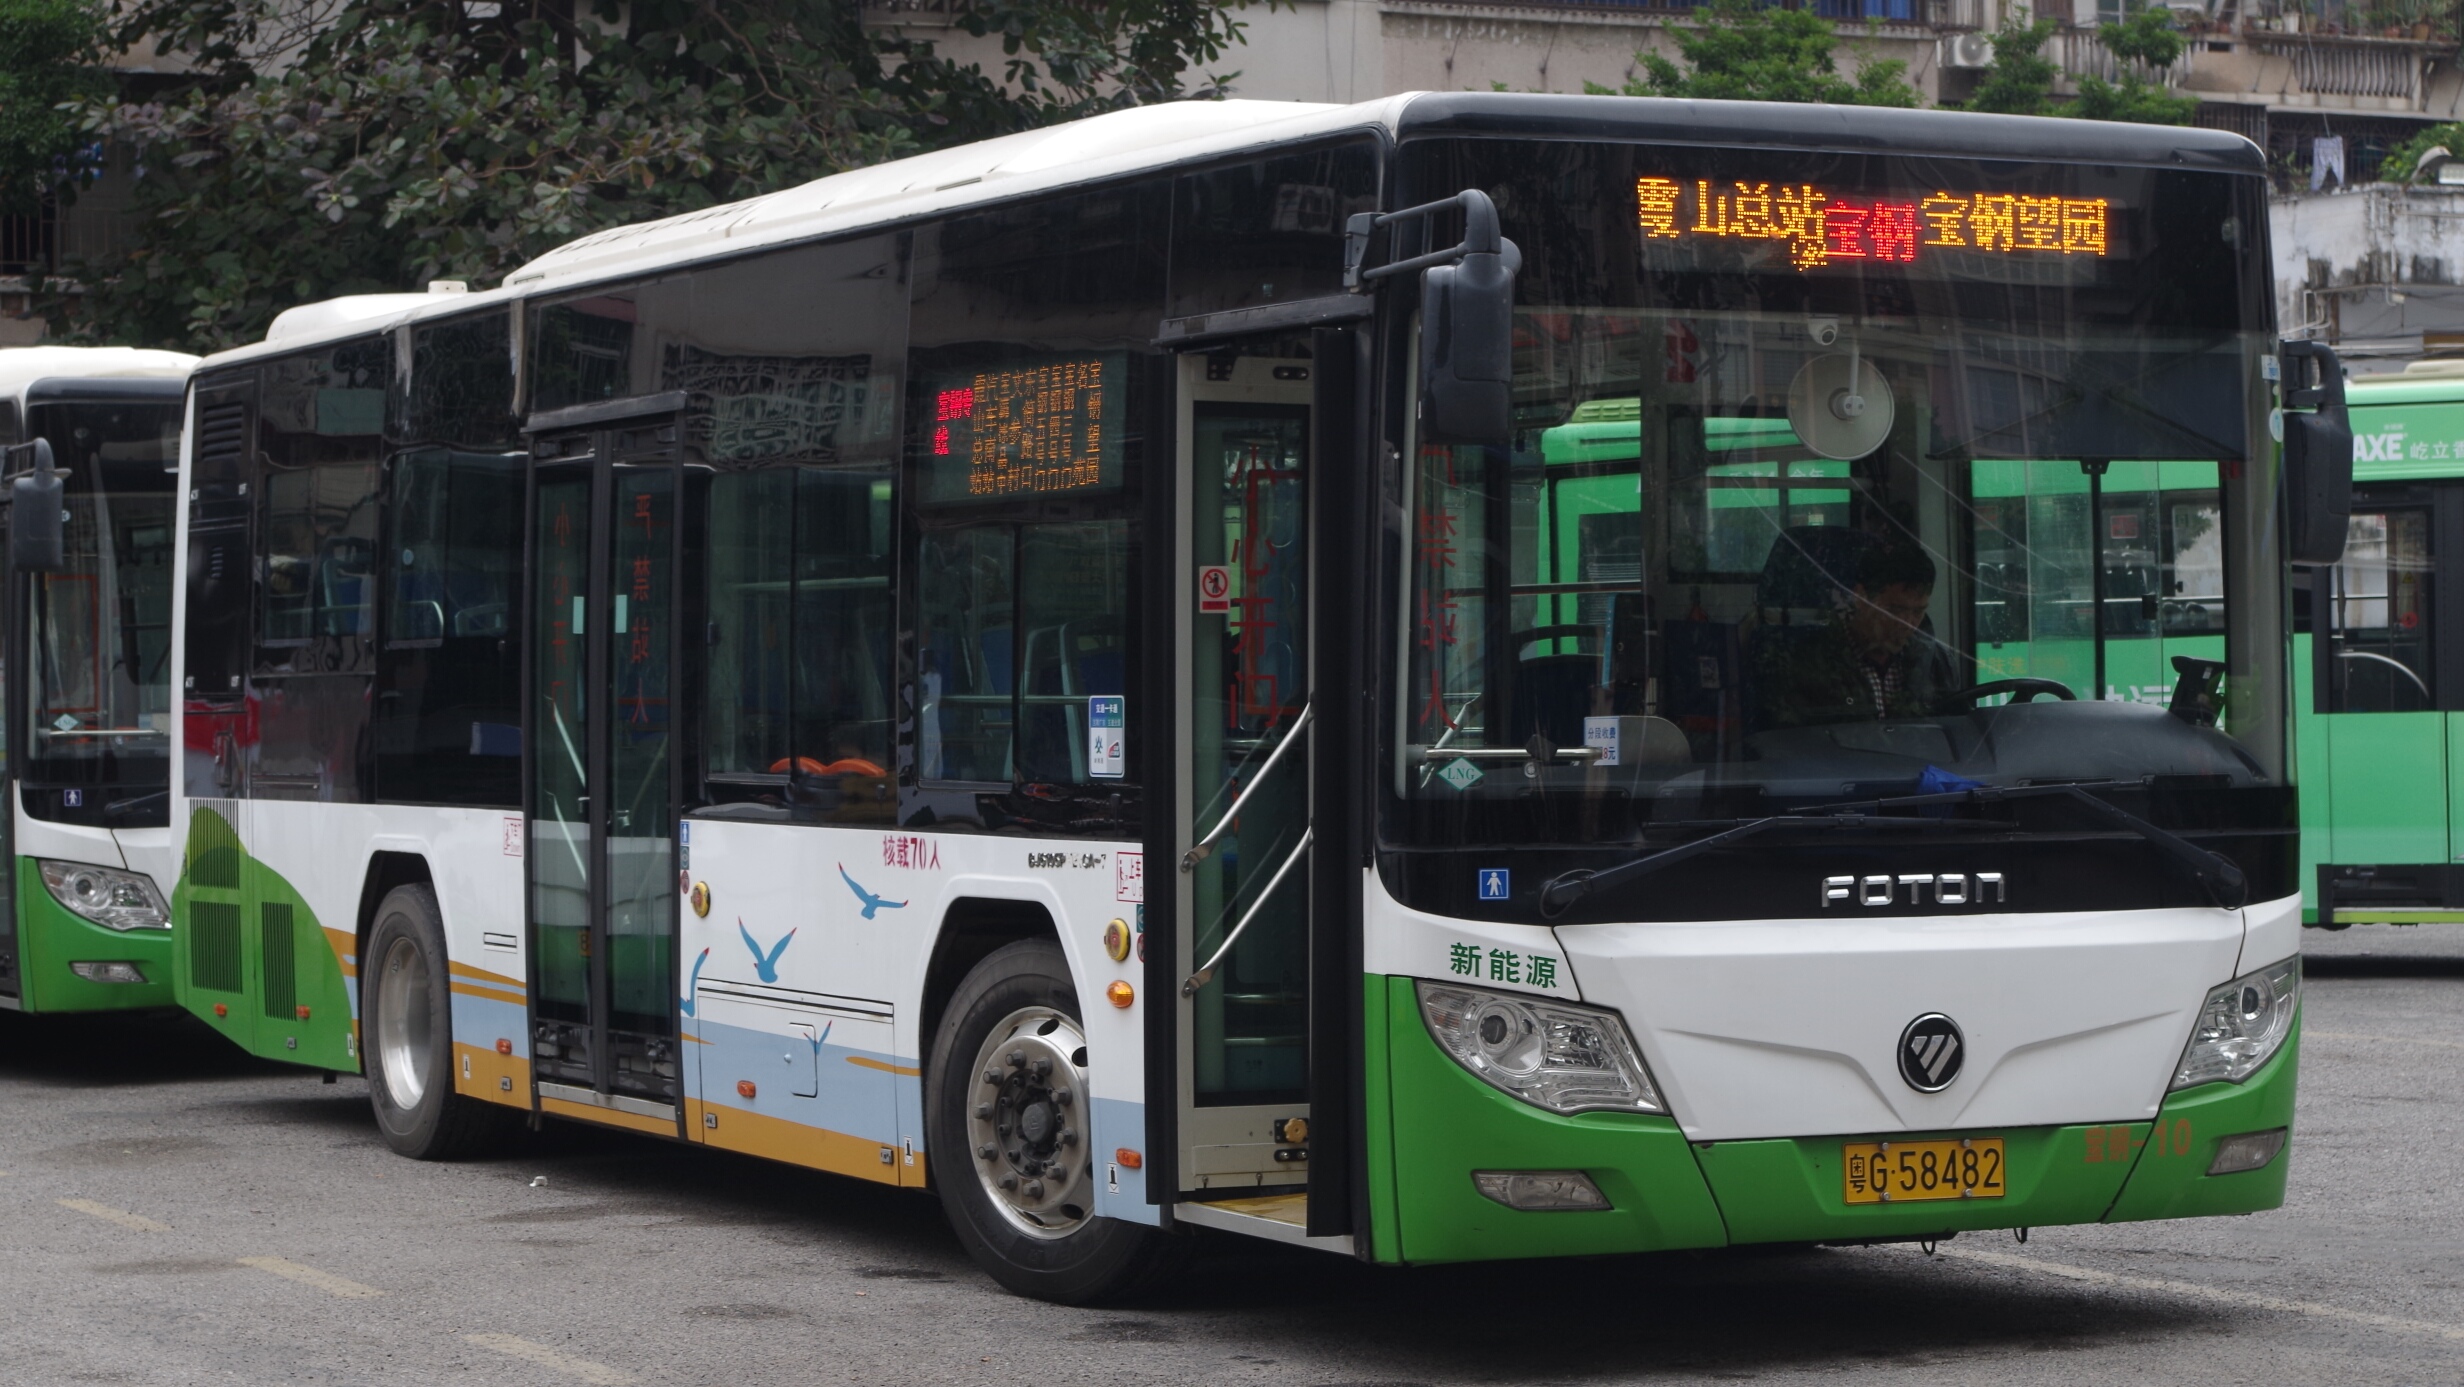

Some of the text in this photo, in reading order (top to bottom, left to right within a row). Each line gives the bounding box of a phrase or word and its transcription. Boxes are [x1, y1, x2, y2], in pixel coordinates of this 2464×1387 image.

[1921, 191, 2108, 256] 宝钢望园
[2353, 433, 2404, 462] AXE
[1587, 726, 1616, 740] 分段收费
[1446, 766, 1476, 781] LNG
[882, 835, 942, 870] 核载70人
[1821, 872, 2005, 908] FOTON
[1449, 942, 1558, 989] 新能源
